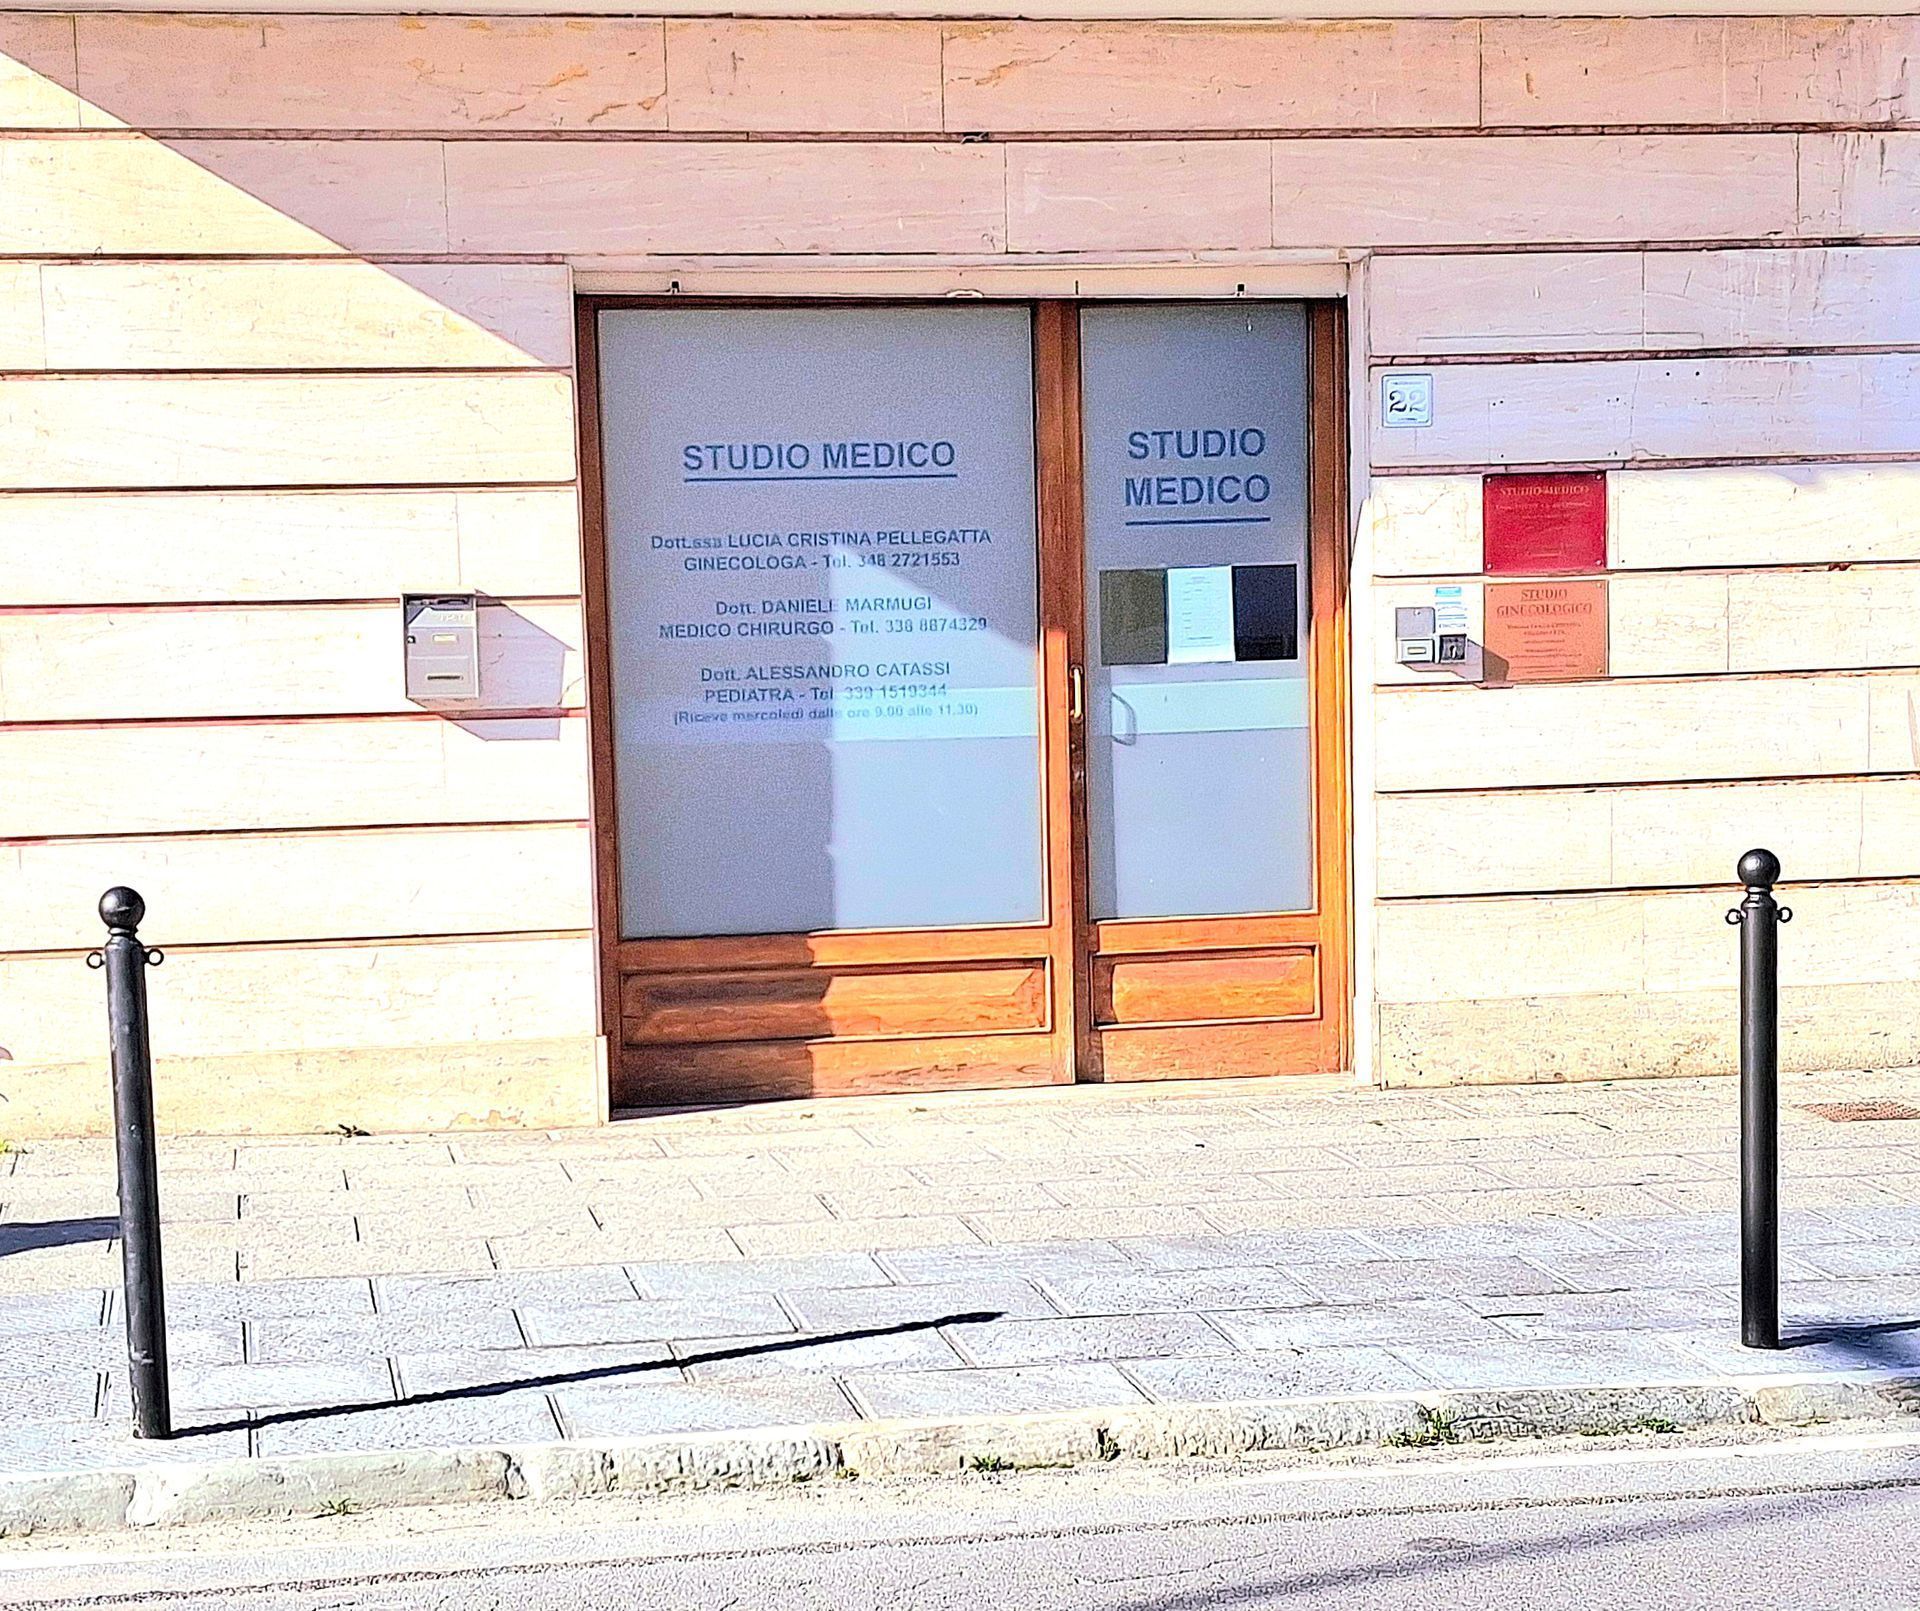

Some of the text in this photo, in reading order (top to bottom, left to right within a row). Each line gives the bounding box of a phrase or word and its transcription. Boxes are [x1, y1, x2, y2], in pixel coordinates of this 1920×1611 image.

[1389, 390, 1426, 412] 22
[1127, 428, 1267, 459] STUDIO
[683, 441, 956, 471] STUDIO MEDICO
[1124, 474, 1270, 506] MEDICO
[728, 533, 783, 548] LUCIA
[787, 531, 872, 548] CRISTINA
[876, 529, 992, 545] PELLEGATTA
[684, 555, 807, 571] GINECOLOGA
[823, 554, 851, 568] Tel.
[891, 551, 960, 567] 2721553
[1521, 589, 1568, 600] STUDIO
[716, 601, 756, 615] Dott.
[845, 597, 931, 612] MARMUGI
[1496, 603, 1592, 616] GINECOLOGICO
[658, 623, 731, 639] MEDICO
[737, 621, 834, 637] CHIRURGO
[851, 619, 879, 634] Tel.
[701, 661, 950, 681] Dott. ALESSANDRO CATASSI
[704, 688, 794, 703] PEDIATRA
